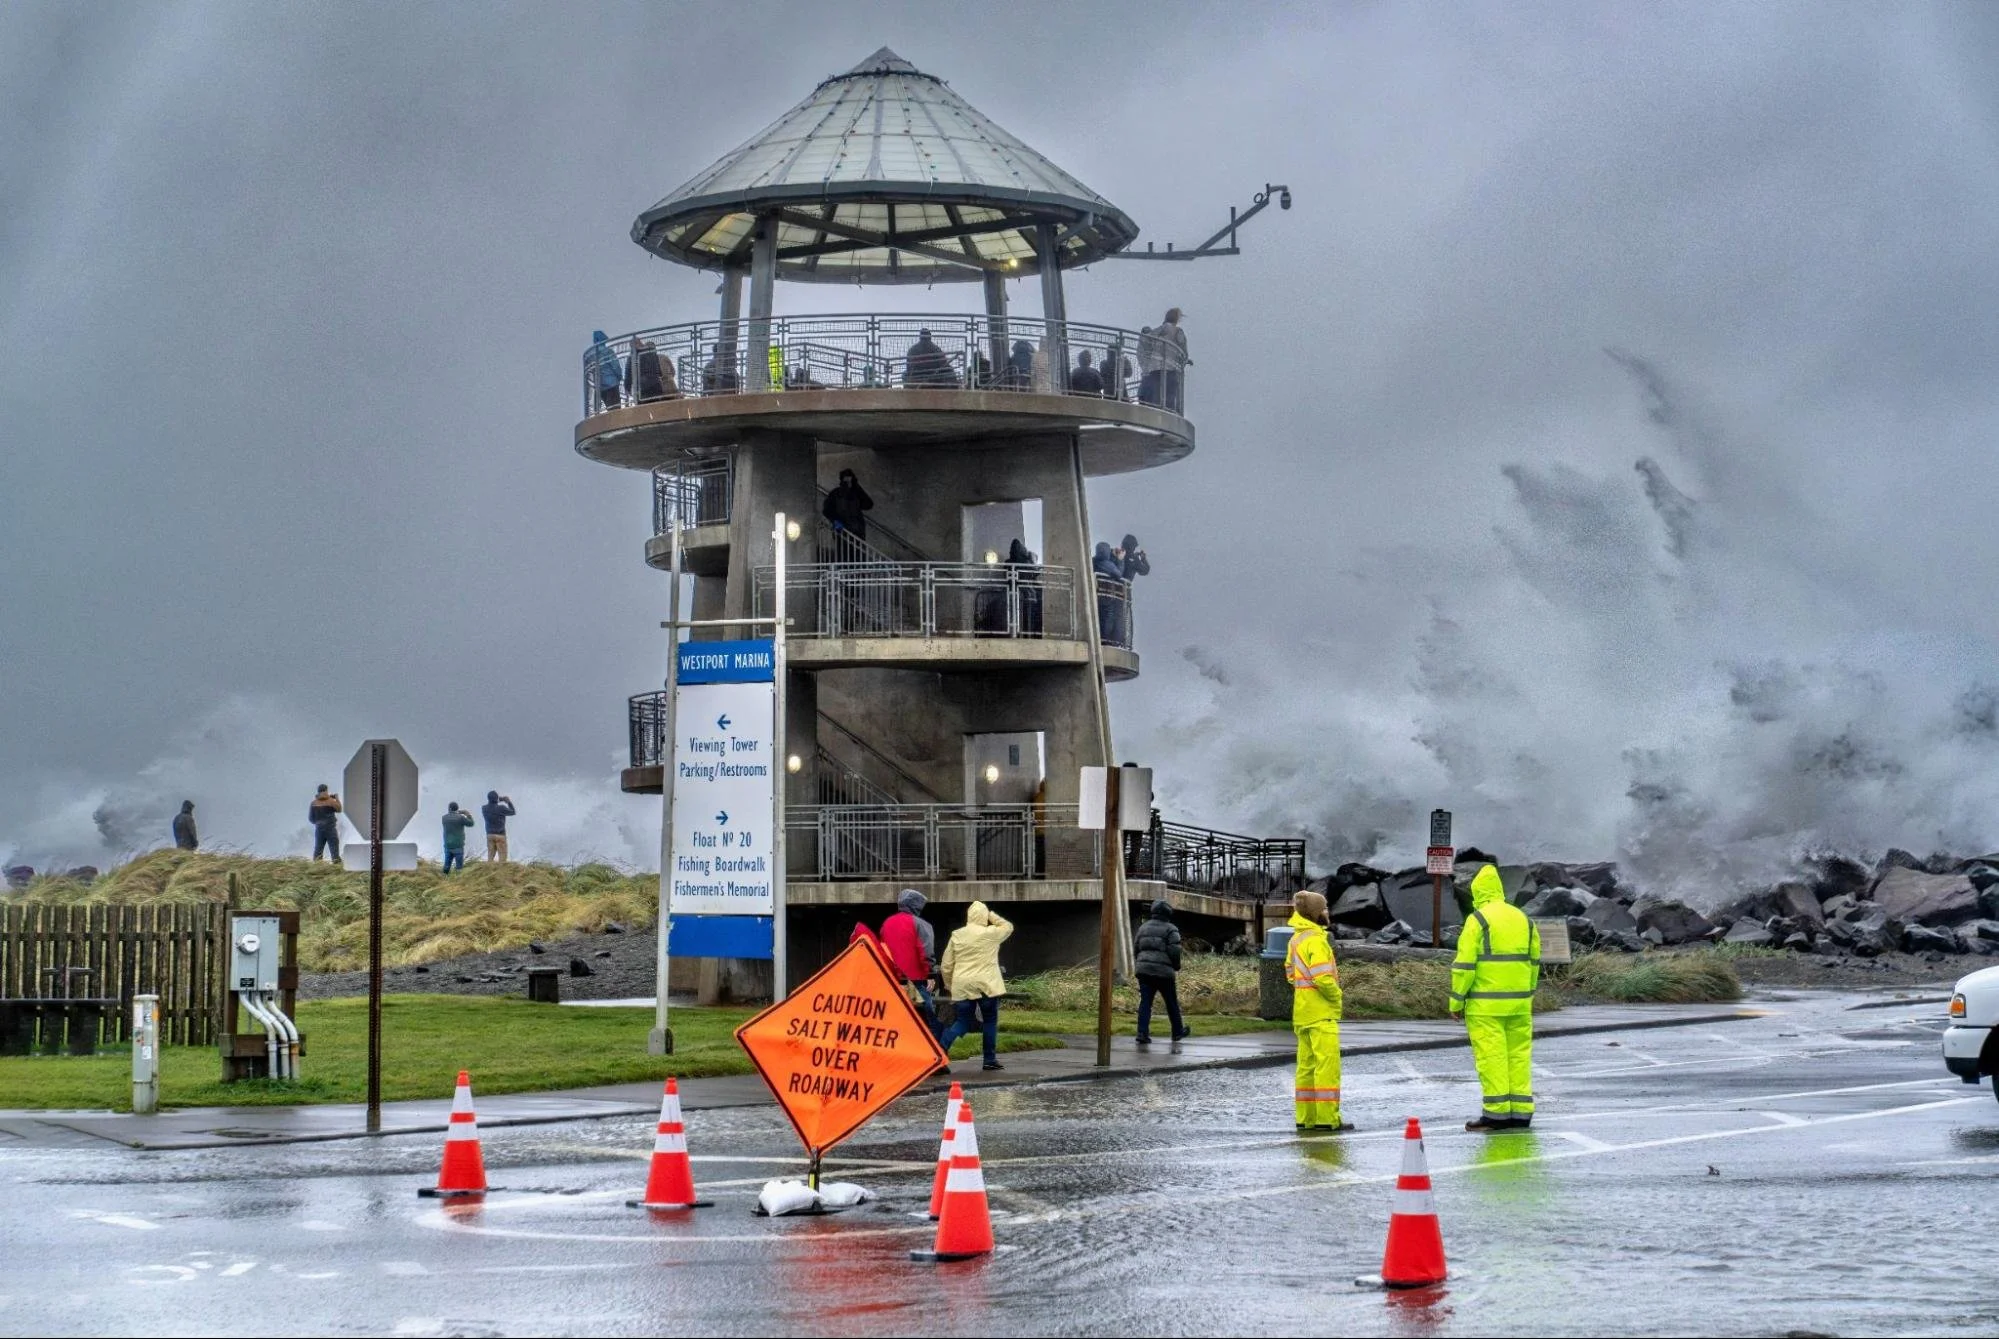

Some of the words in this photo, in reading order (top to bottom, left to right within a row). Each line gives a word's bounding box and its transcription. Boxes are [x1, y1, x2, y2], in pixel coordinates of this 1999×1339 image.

[681, 654, 729, 671] WESTPORT
[734, 652, 770, 669] MARINA
[689, 737, 726, 757] Viewing
[731, 736, 759, 753] Tower
[680, 761, 767, 782] Parking/Restrooms
[693, 831, 717, 848] Float
[739, 831, 752, 848] 20
[678, 856, 710, 877] Fishing
[715, 856, 766, 872] Boardwalk
[674, 880, 725, 897] Fishermen's
[727, 881, 769, 897] Memorial
[812, 993, 887, 1021] CAUTION
[786, 1017, 832, 1041] SALT
[836, 1021, 899, 1050] WATER
[811, 1046, 860, 1073] OVER
[788, 1072, 874, 1103] ROADWAY
